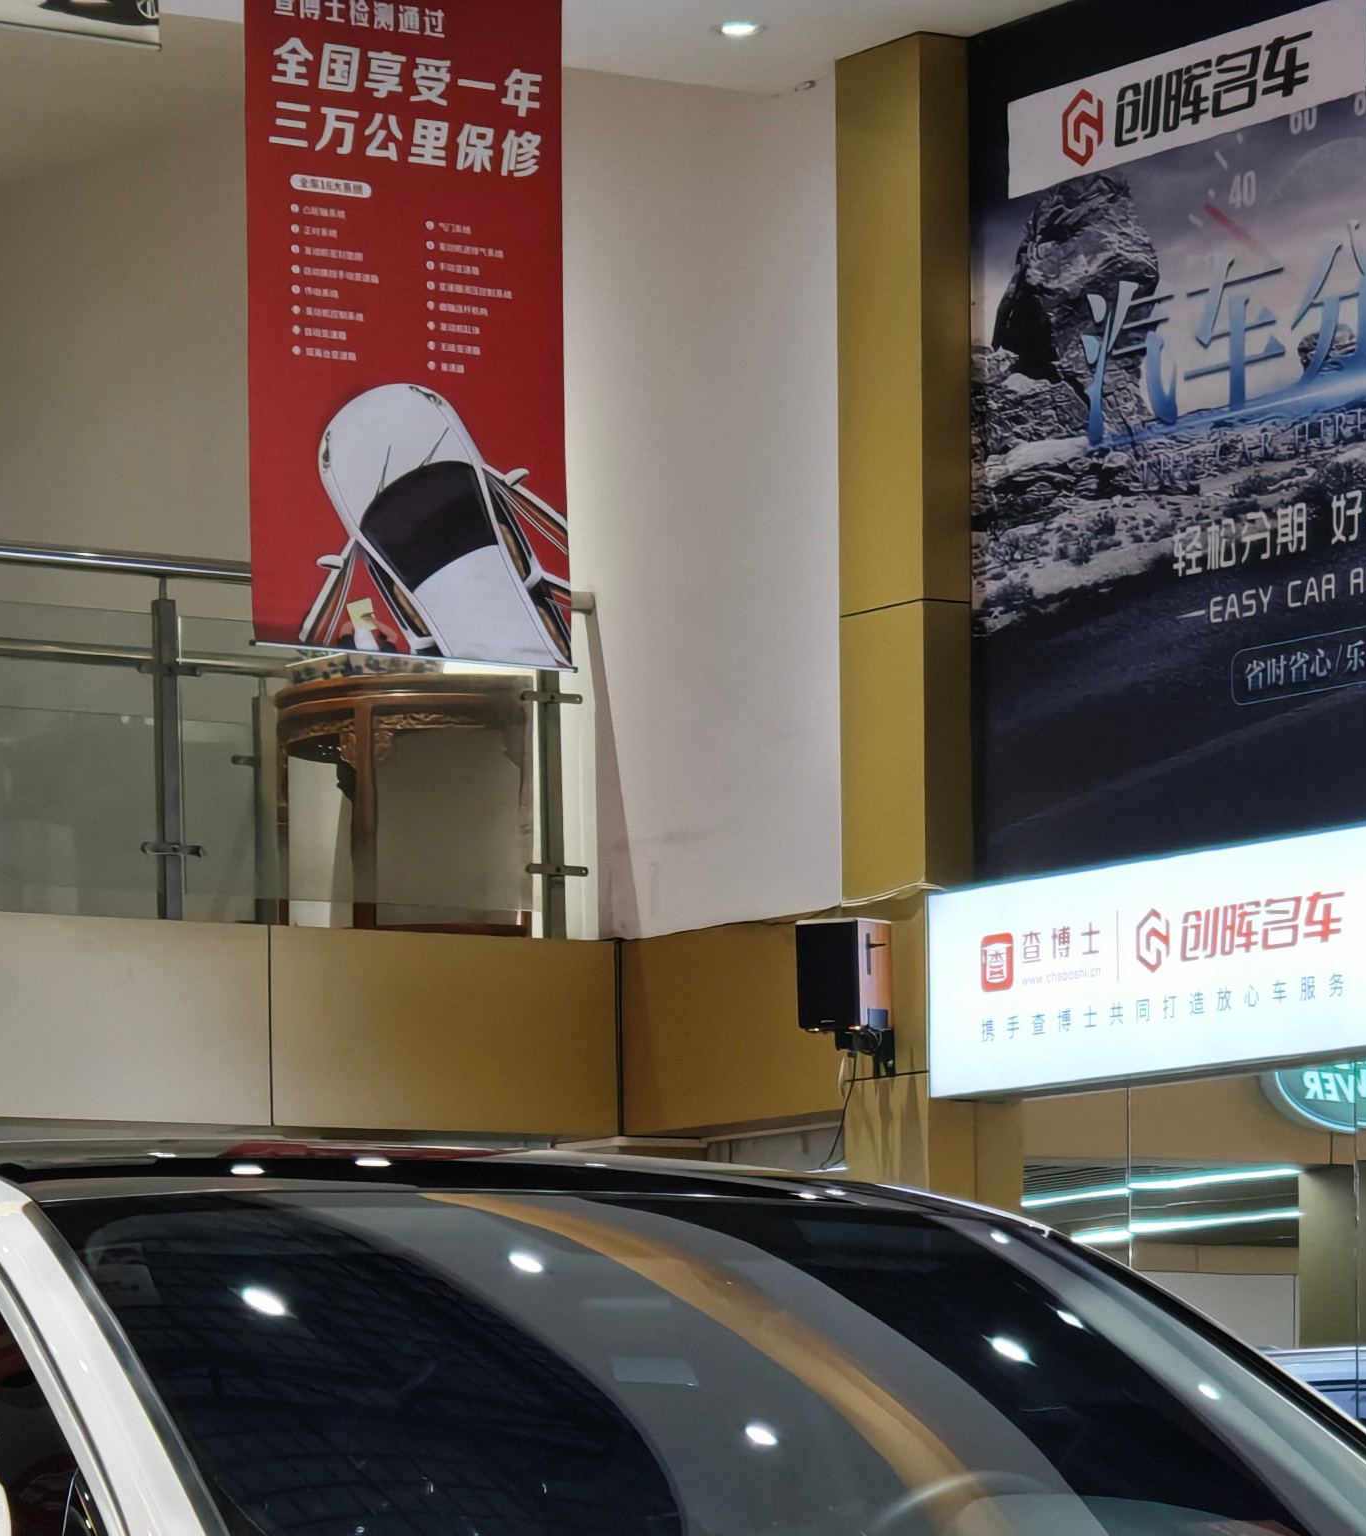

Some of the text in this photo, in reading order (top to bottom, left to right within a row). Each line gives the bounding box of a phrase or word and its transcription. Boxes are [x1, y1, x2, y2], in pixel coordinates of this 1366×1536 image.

[271, 37, 543, 117] 全国享受一年
[1113, 31, 1313, 149] 创晖名车
[269, 101, 542, 178] 三万公里保修
[1173, 502, 1307, 577] 轻松分期
[1209, 585, 1273, 624] EASY
[1287, 574, 1336, 608] CAR
[1021, 922, 1101, 964] 查博士
[1180, 892, 1345, 962] 创晖名车
[981, 973, 1345, 1042] 携手查博士共同打造放心车服务
[1021, 966, 1101, 987] www.chaboshi.cn
